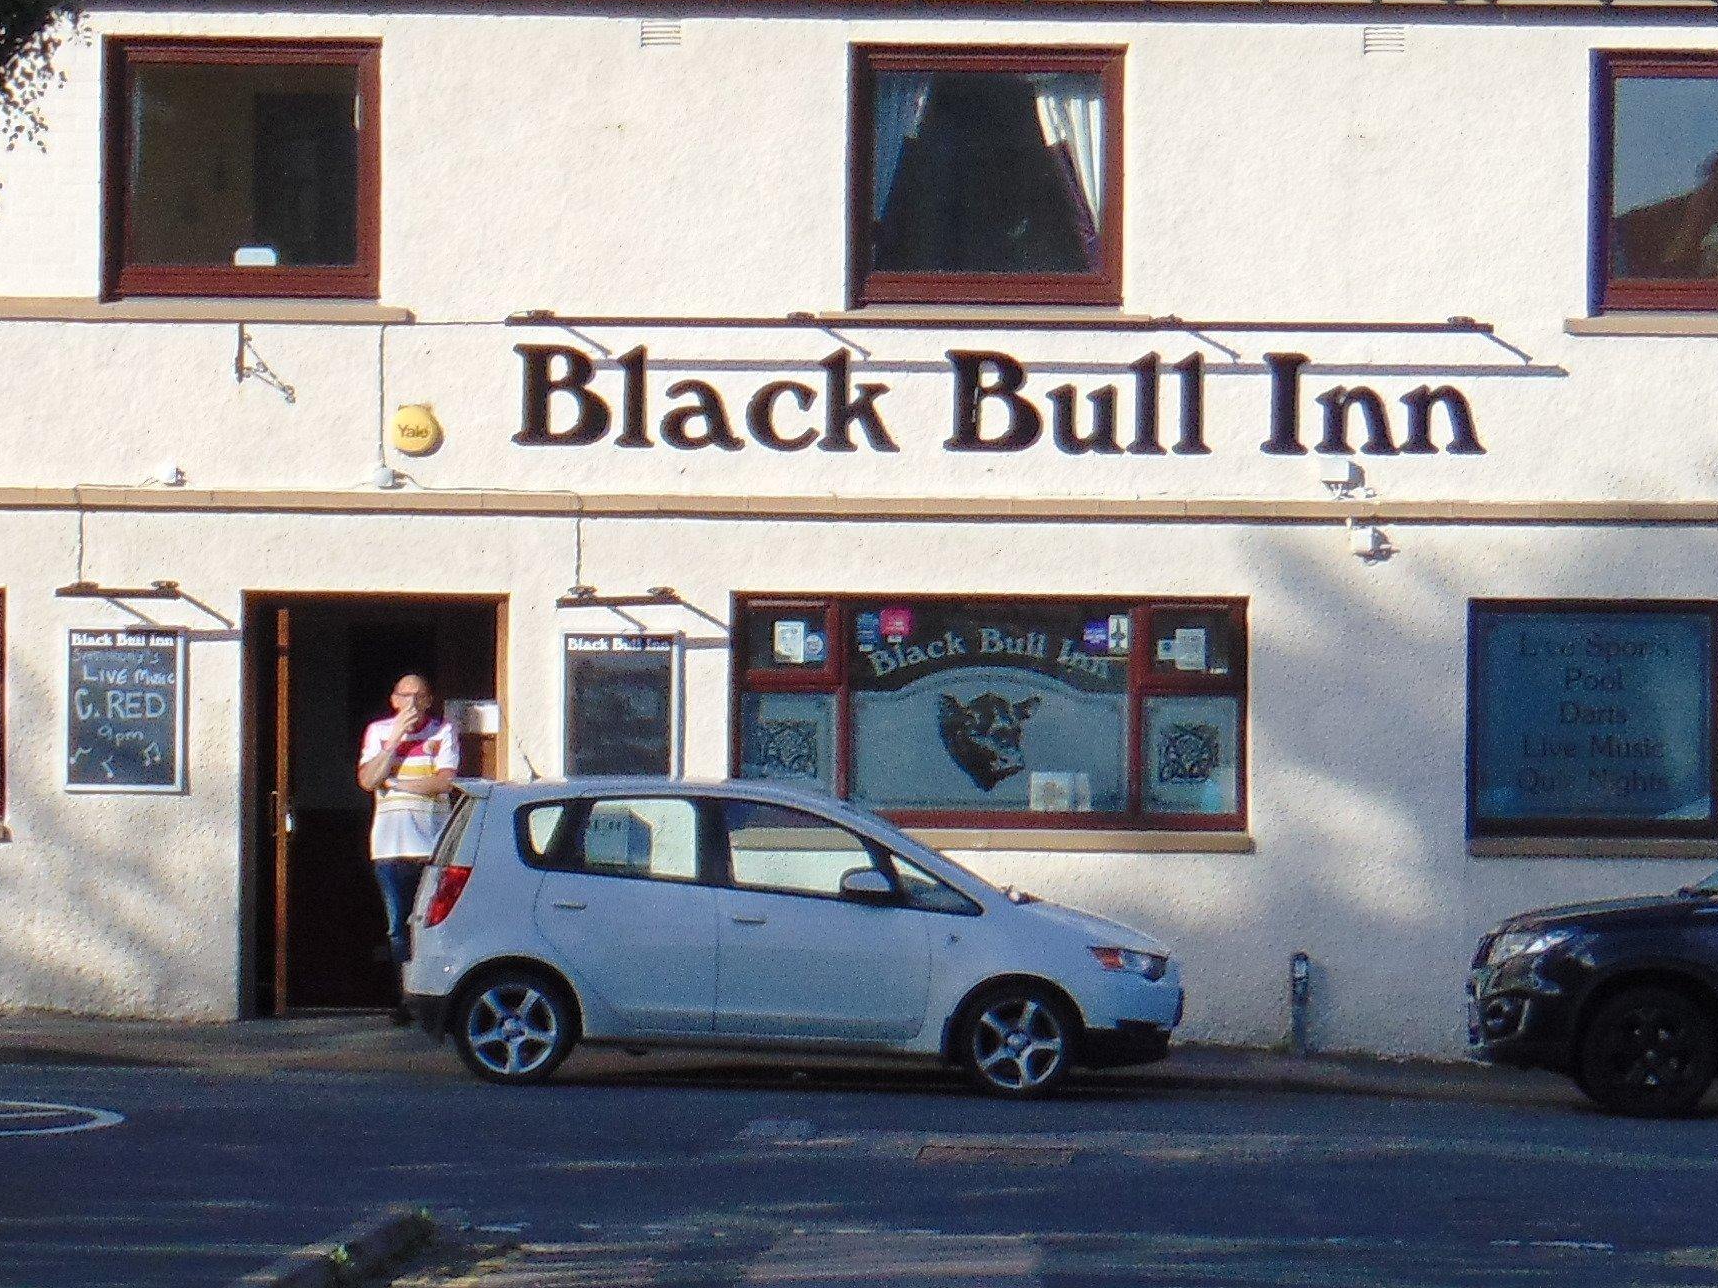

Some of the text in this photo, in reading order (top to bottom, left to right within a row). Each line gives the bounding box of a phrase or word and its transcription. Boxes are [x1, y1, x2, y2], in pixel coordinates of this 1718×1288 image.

[512, 341, 1487, 455] Black Bull Inn
[71, 633, 113, 646] Black
[116, 633, 146, 646] Bull
[567, 638, 610, 651] Black
[612, 638, 642, 651] Bull
[869, 630, 967, 677] Black
[979, 626, 1048, 659] Bull
[1563, 667, 1625, 691] Pool
[106, 689, 166, 720] RED
[1559, 701, 1629, 725] Darts
[1521, 734, 1664, 758] Live Music
